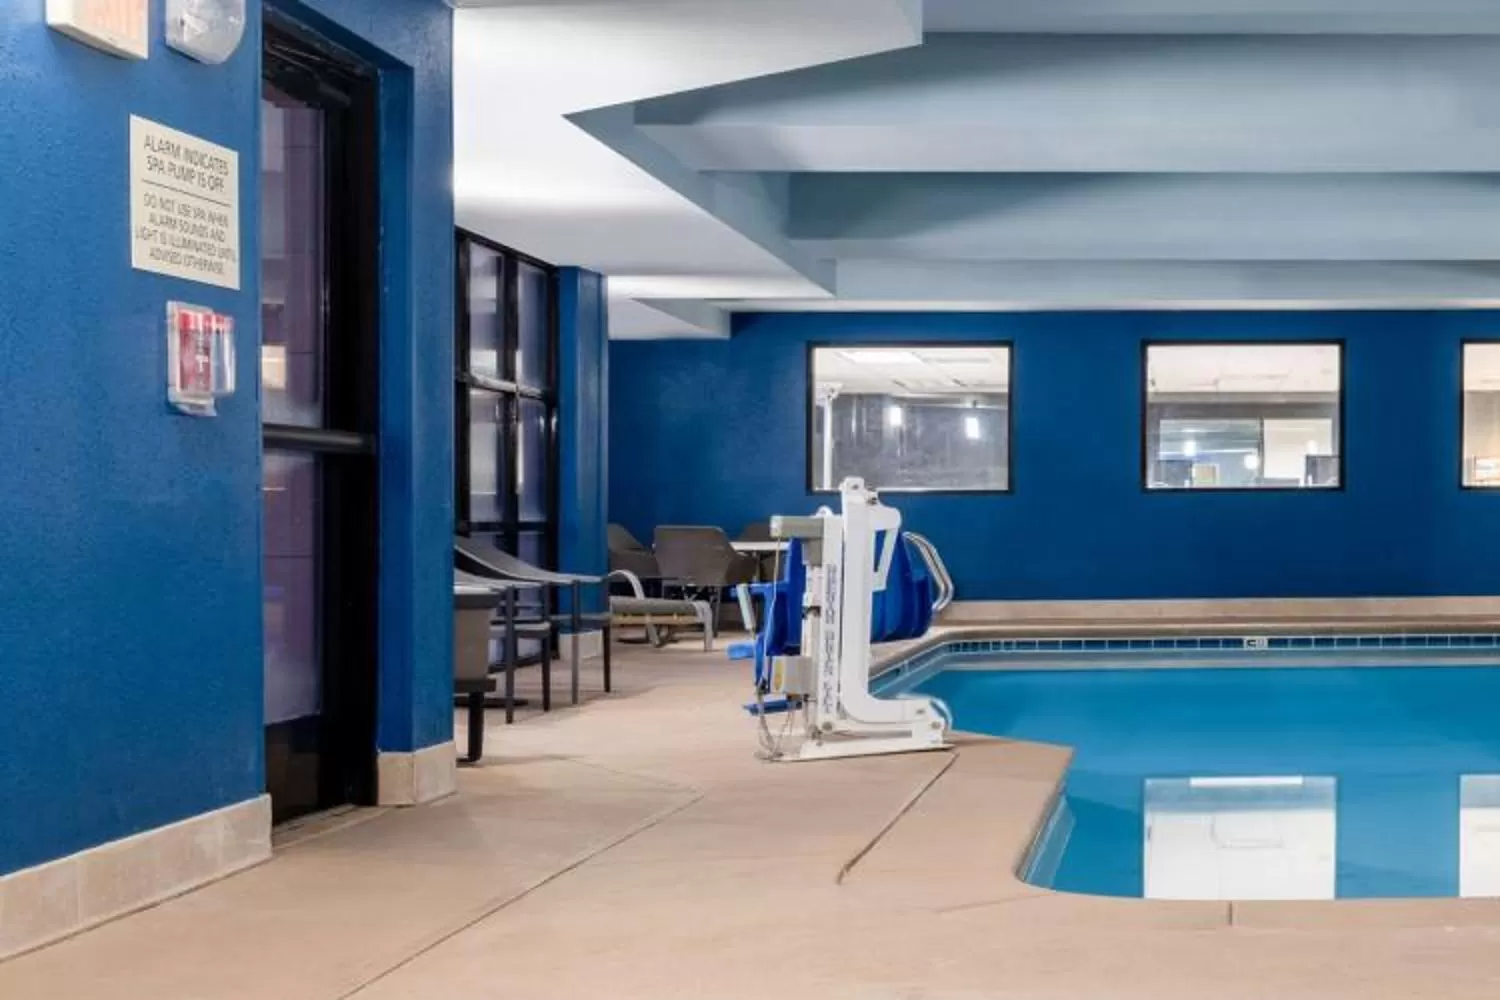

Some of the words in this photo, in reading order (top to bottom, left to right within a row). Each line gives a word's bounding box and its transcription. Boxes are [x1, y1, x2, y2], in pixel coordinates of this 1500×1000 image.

[143, 133, 180, 159] ALARM
[183, 146, 228, 177] INDICATES
[145, 154, 165, 175] SPA
[167, 160, 195, 185] PUMP
[207, 174, 225, 193] OFF
[159, 196, 175, 213] NOT
